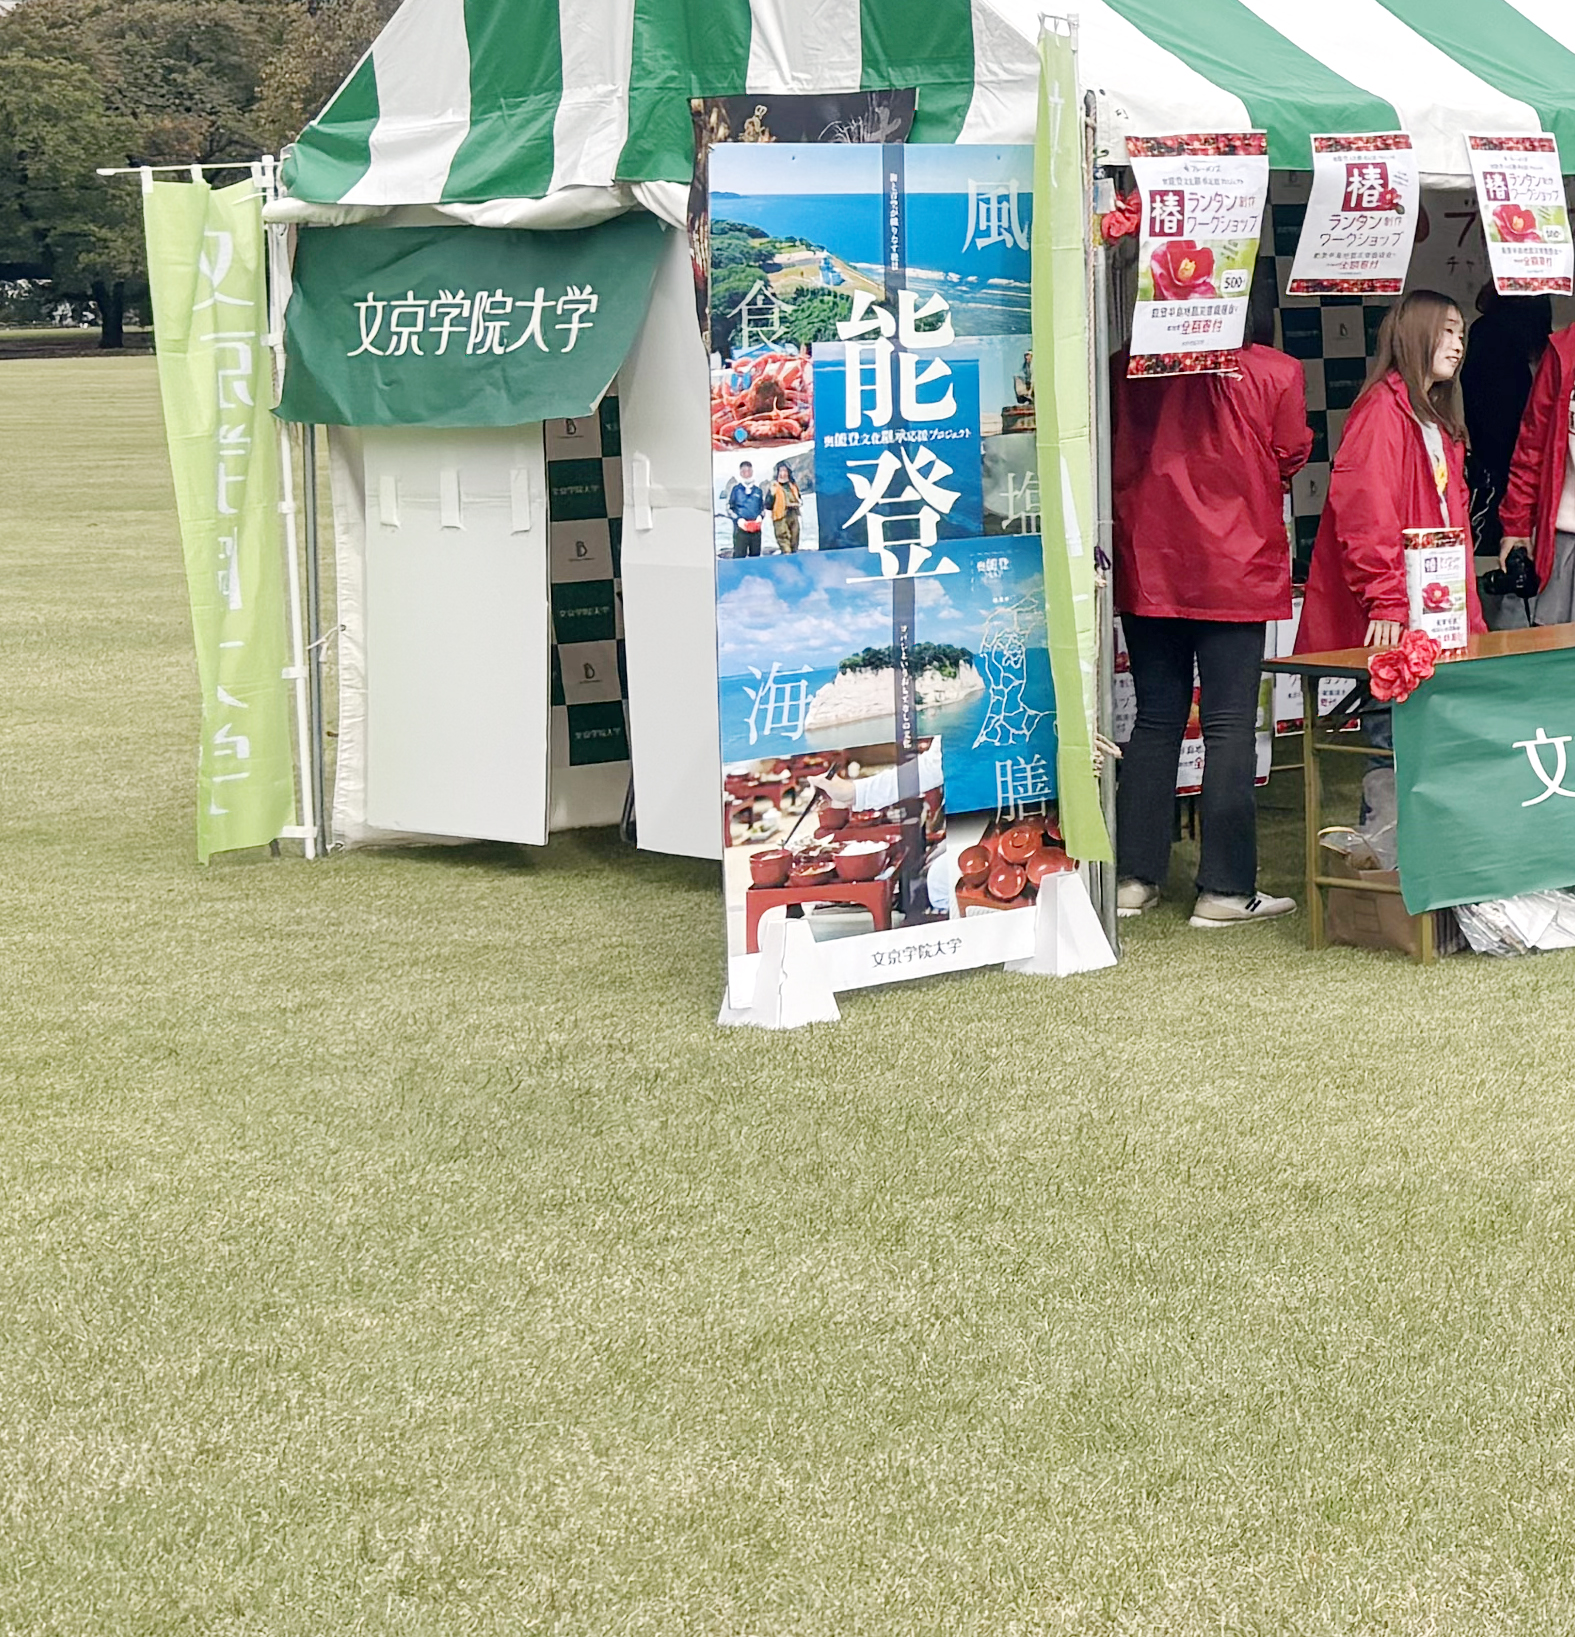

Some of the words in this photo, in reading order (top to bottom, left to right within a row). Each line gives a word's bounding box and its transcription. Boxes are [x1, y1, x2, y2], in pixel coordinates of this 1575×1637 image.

[1347, 164, 1384, 207] 椿
[1486, 173, 1508, 200] 椿
[962, 178, 1030, 253] 風
[1151, 192, 1183, 233] 椿
[1187, 215, 1259, 234] ワークショップ
[1319, 231, 1404, 248] ワークショップ
[347, 284, 599, 357] 文京学院大学
[835, 289, 961, 583] 能登
[742, 661, 815, 746] 海
[871, 937, 963, 969] 文京学院大学
